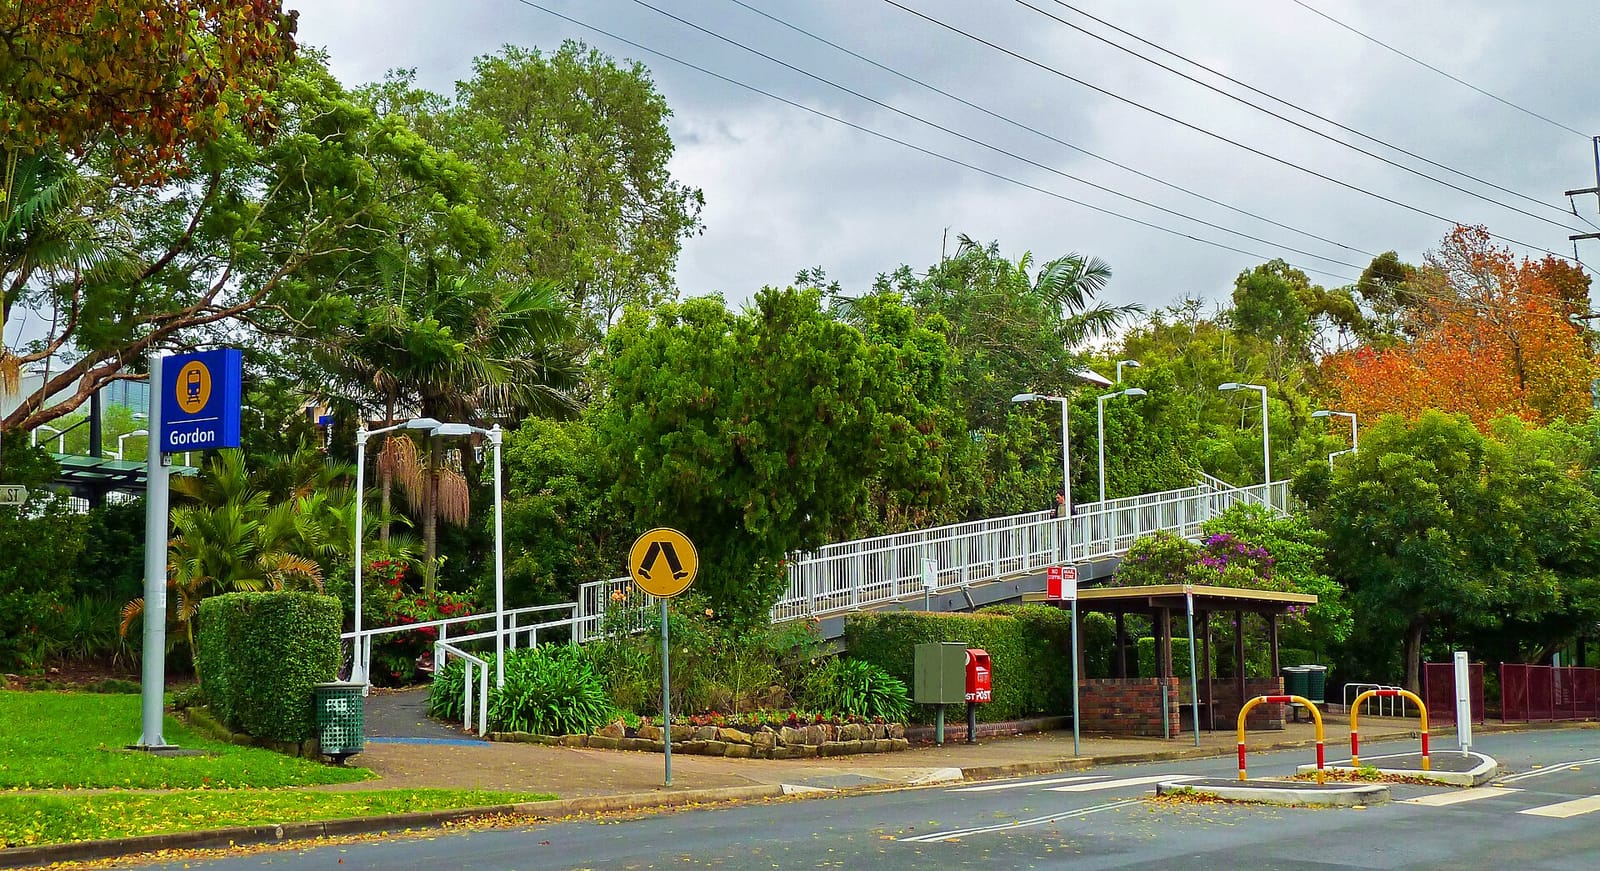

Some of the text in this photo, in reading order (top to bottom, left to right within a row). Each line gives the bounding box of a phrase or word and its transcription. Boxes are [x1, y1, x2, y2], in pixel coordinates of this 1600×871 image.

[170, 427, 215, 445] Gordon
[8, 489, 19, 502] ST
[965, 693, 976, 701] ST
[976, 690, 991, 701] POST
